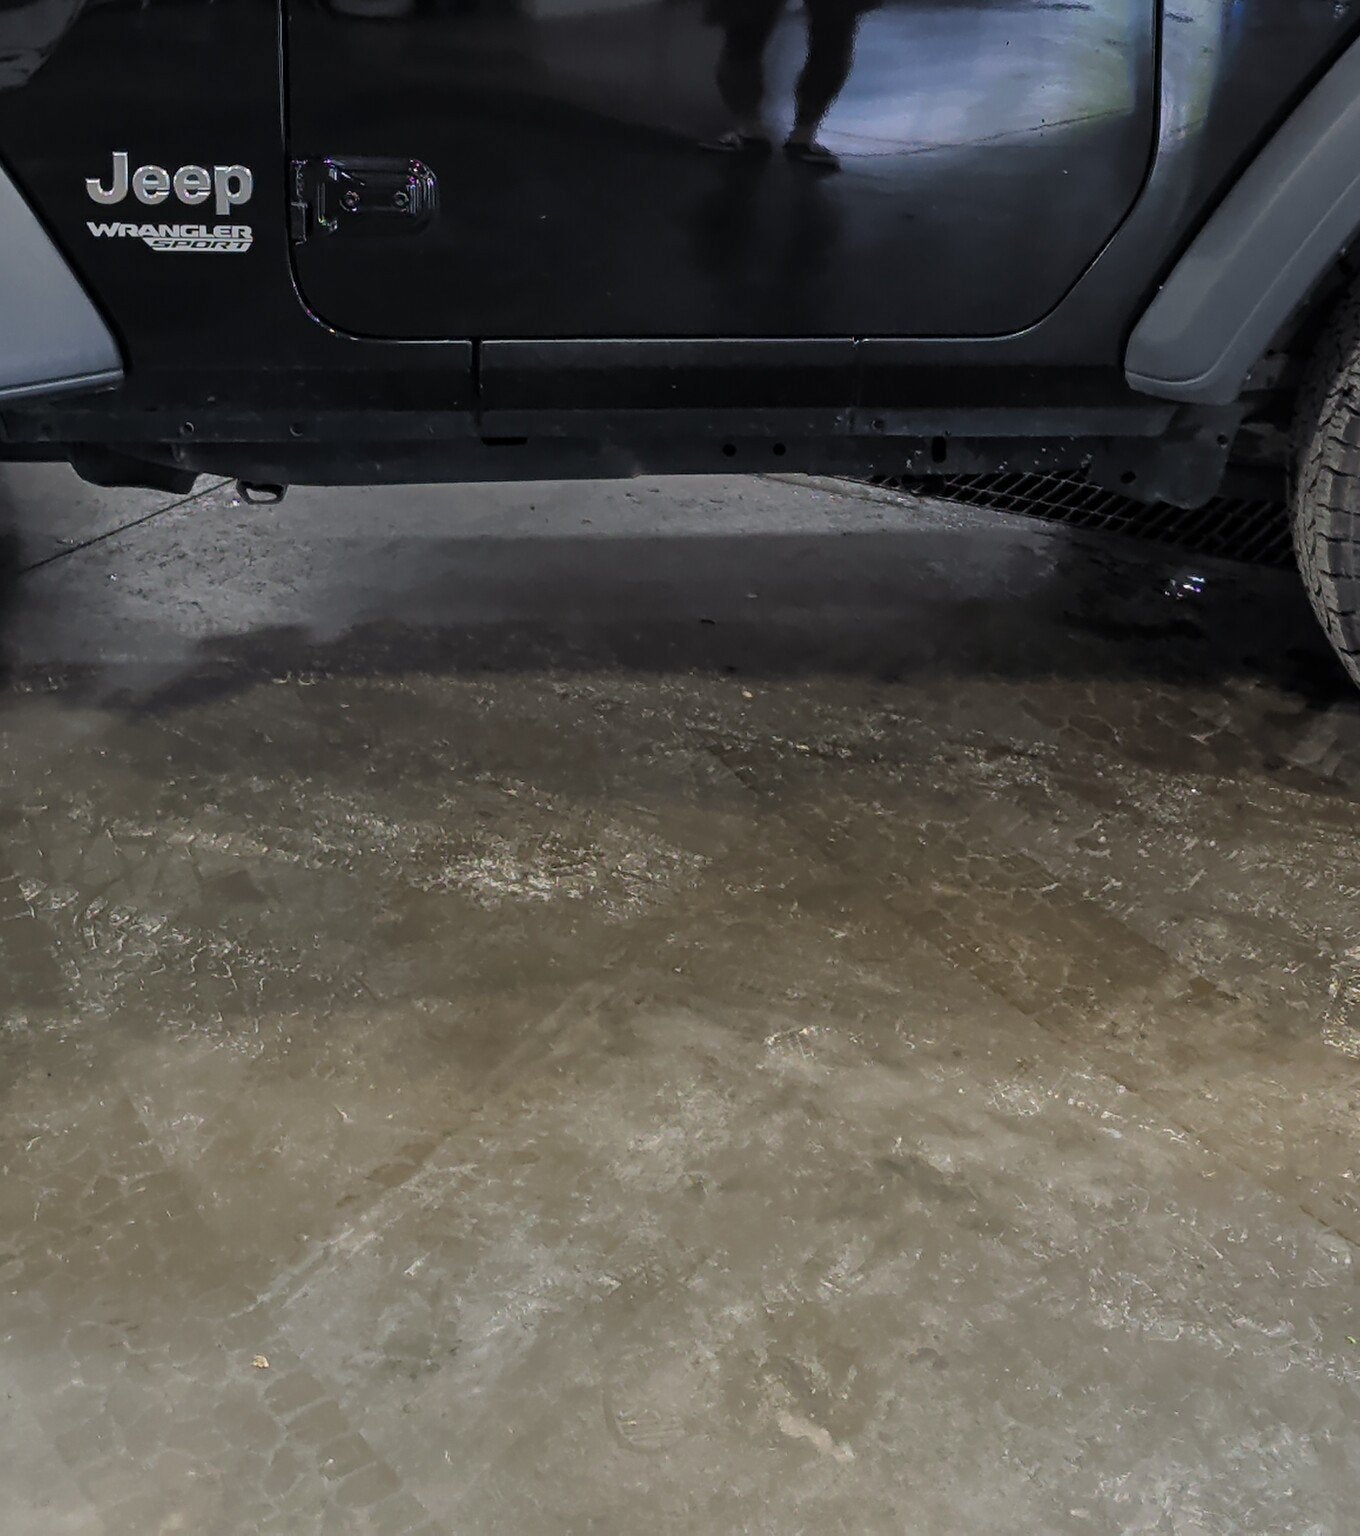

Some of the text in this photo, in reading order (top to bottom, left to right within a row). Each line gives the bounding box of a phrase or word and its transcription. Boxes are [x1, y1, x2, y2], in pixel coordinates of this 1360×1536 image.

[85, 150, 254, 216] Jeep
[86, 221, 254, 238] WRANGLER
[151, 240, 248, 249] SPORT
